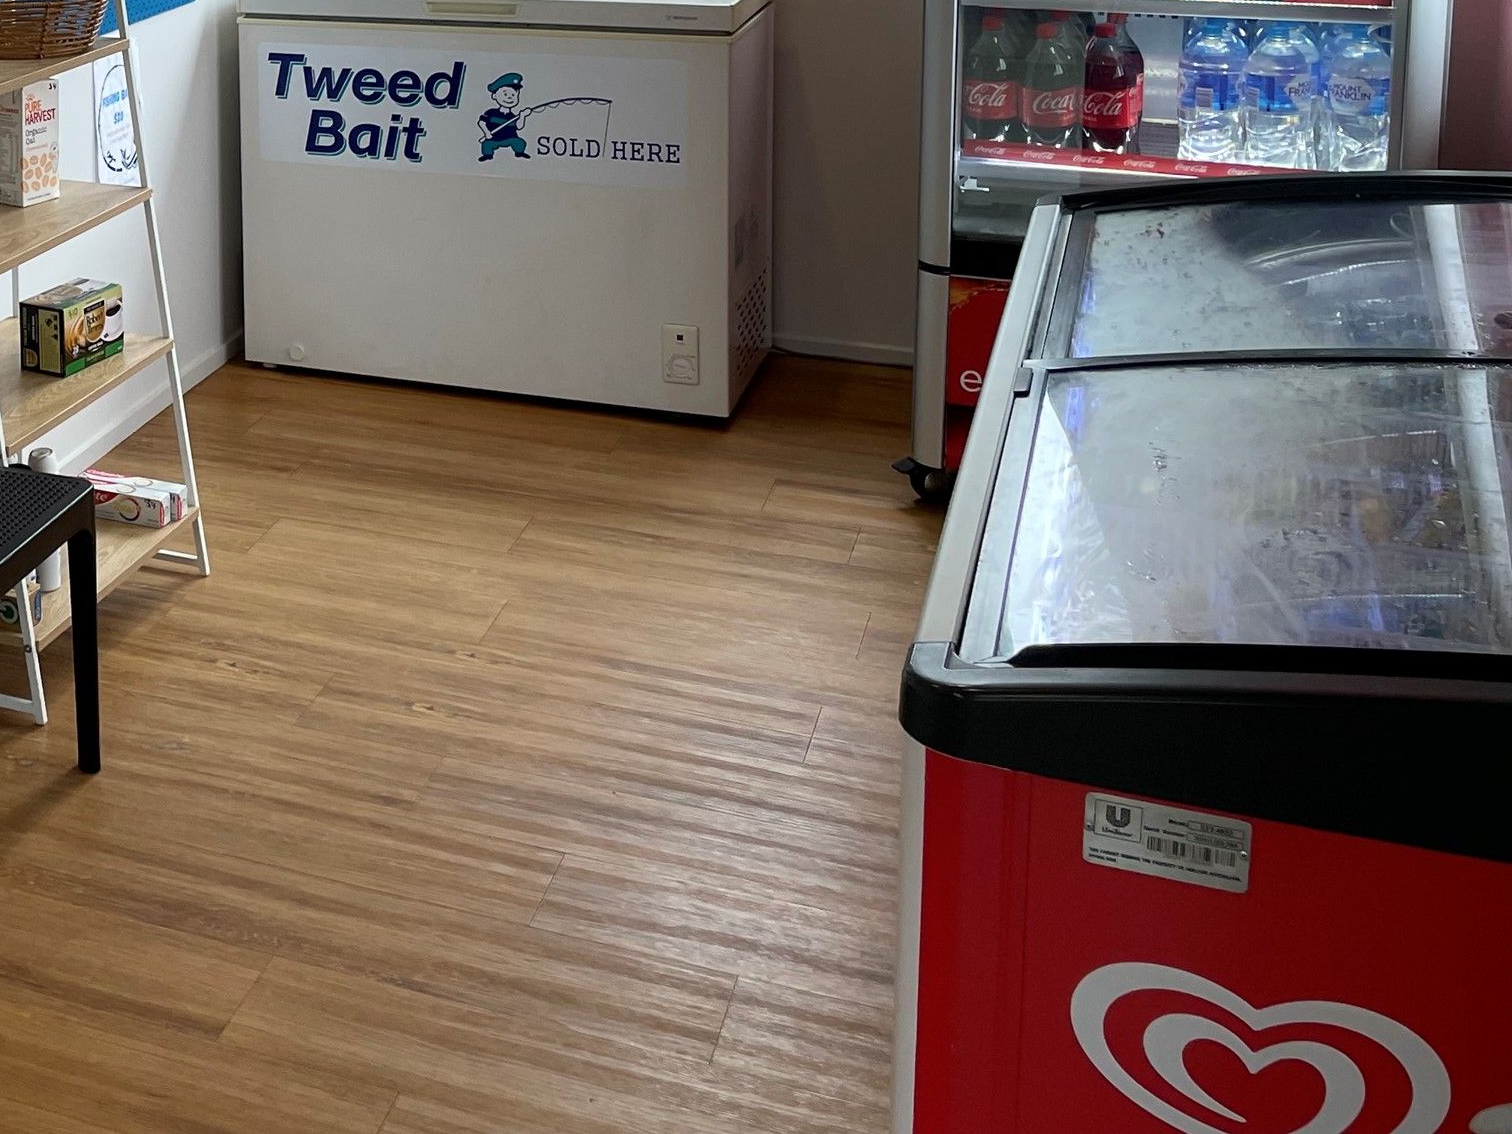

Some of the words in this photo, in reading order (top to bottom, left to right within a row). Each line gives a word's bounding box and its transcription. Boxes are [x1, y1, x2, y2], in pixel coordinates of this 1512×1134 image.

[267, 52, 466, 110] Tweed
[1334, 84, 1361, 94] MOUNT
[25, 99, 42, 112] PURE
[24, 108, 56, 126] HARVEST
[25, 127, 47, 137] Organic
[304, 109, 427, 164] Bait
[536, 136, 600, 159] SOLD
[610, 141, 682, 165] HERE
[975, 146, 1006, 155] Coca-Cola
[1023, 150, 1055, 160] Coca-Cola
[1073, 155, 1106, 164] Coca-Cola
[1124, 159, 1156, 168] Coca-Cola
[1175, 163, 1207, 173] Coca-Cola
[1106, 804, 1131, 828] U
